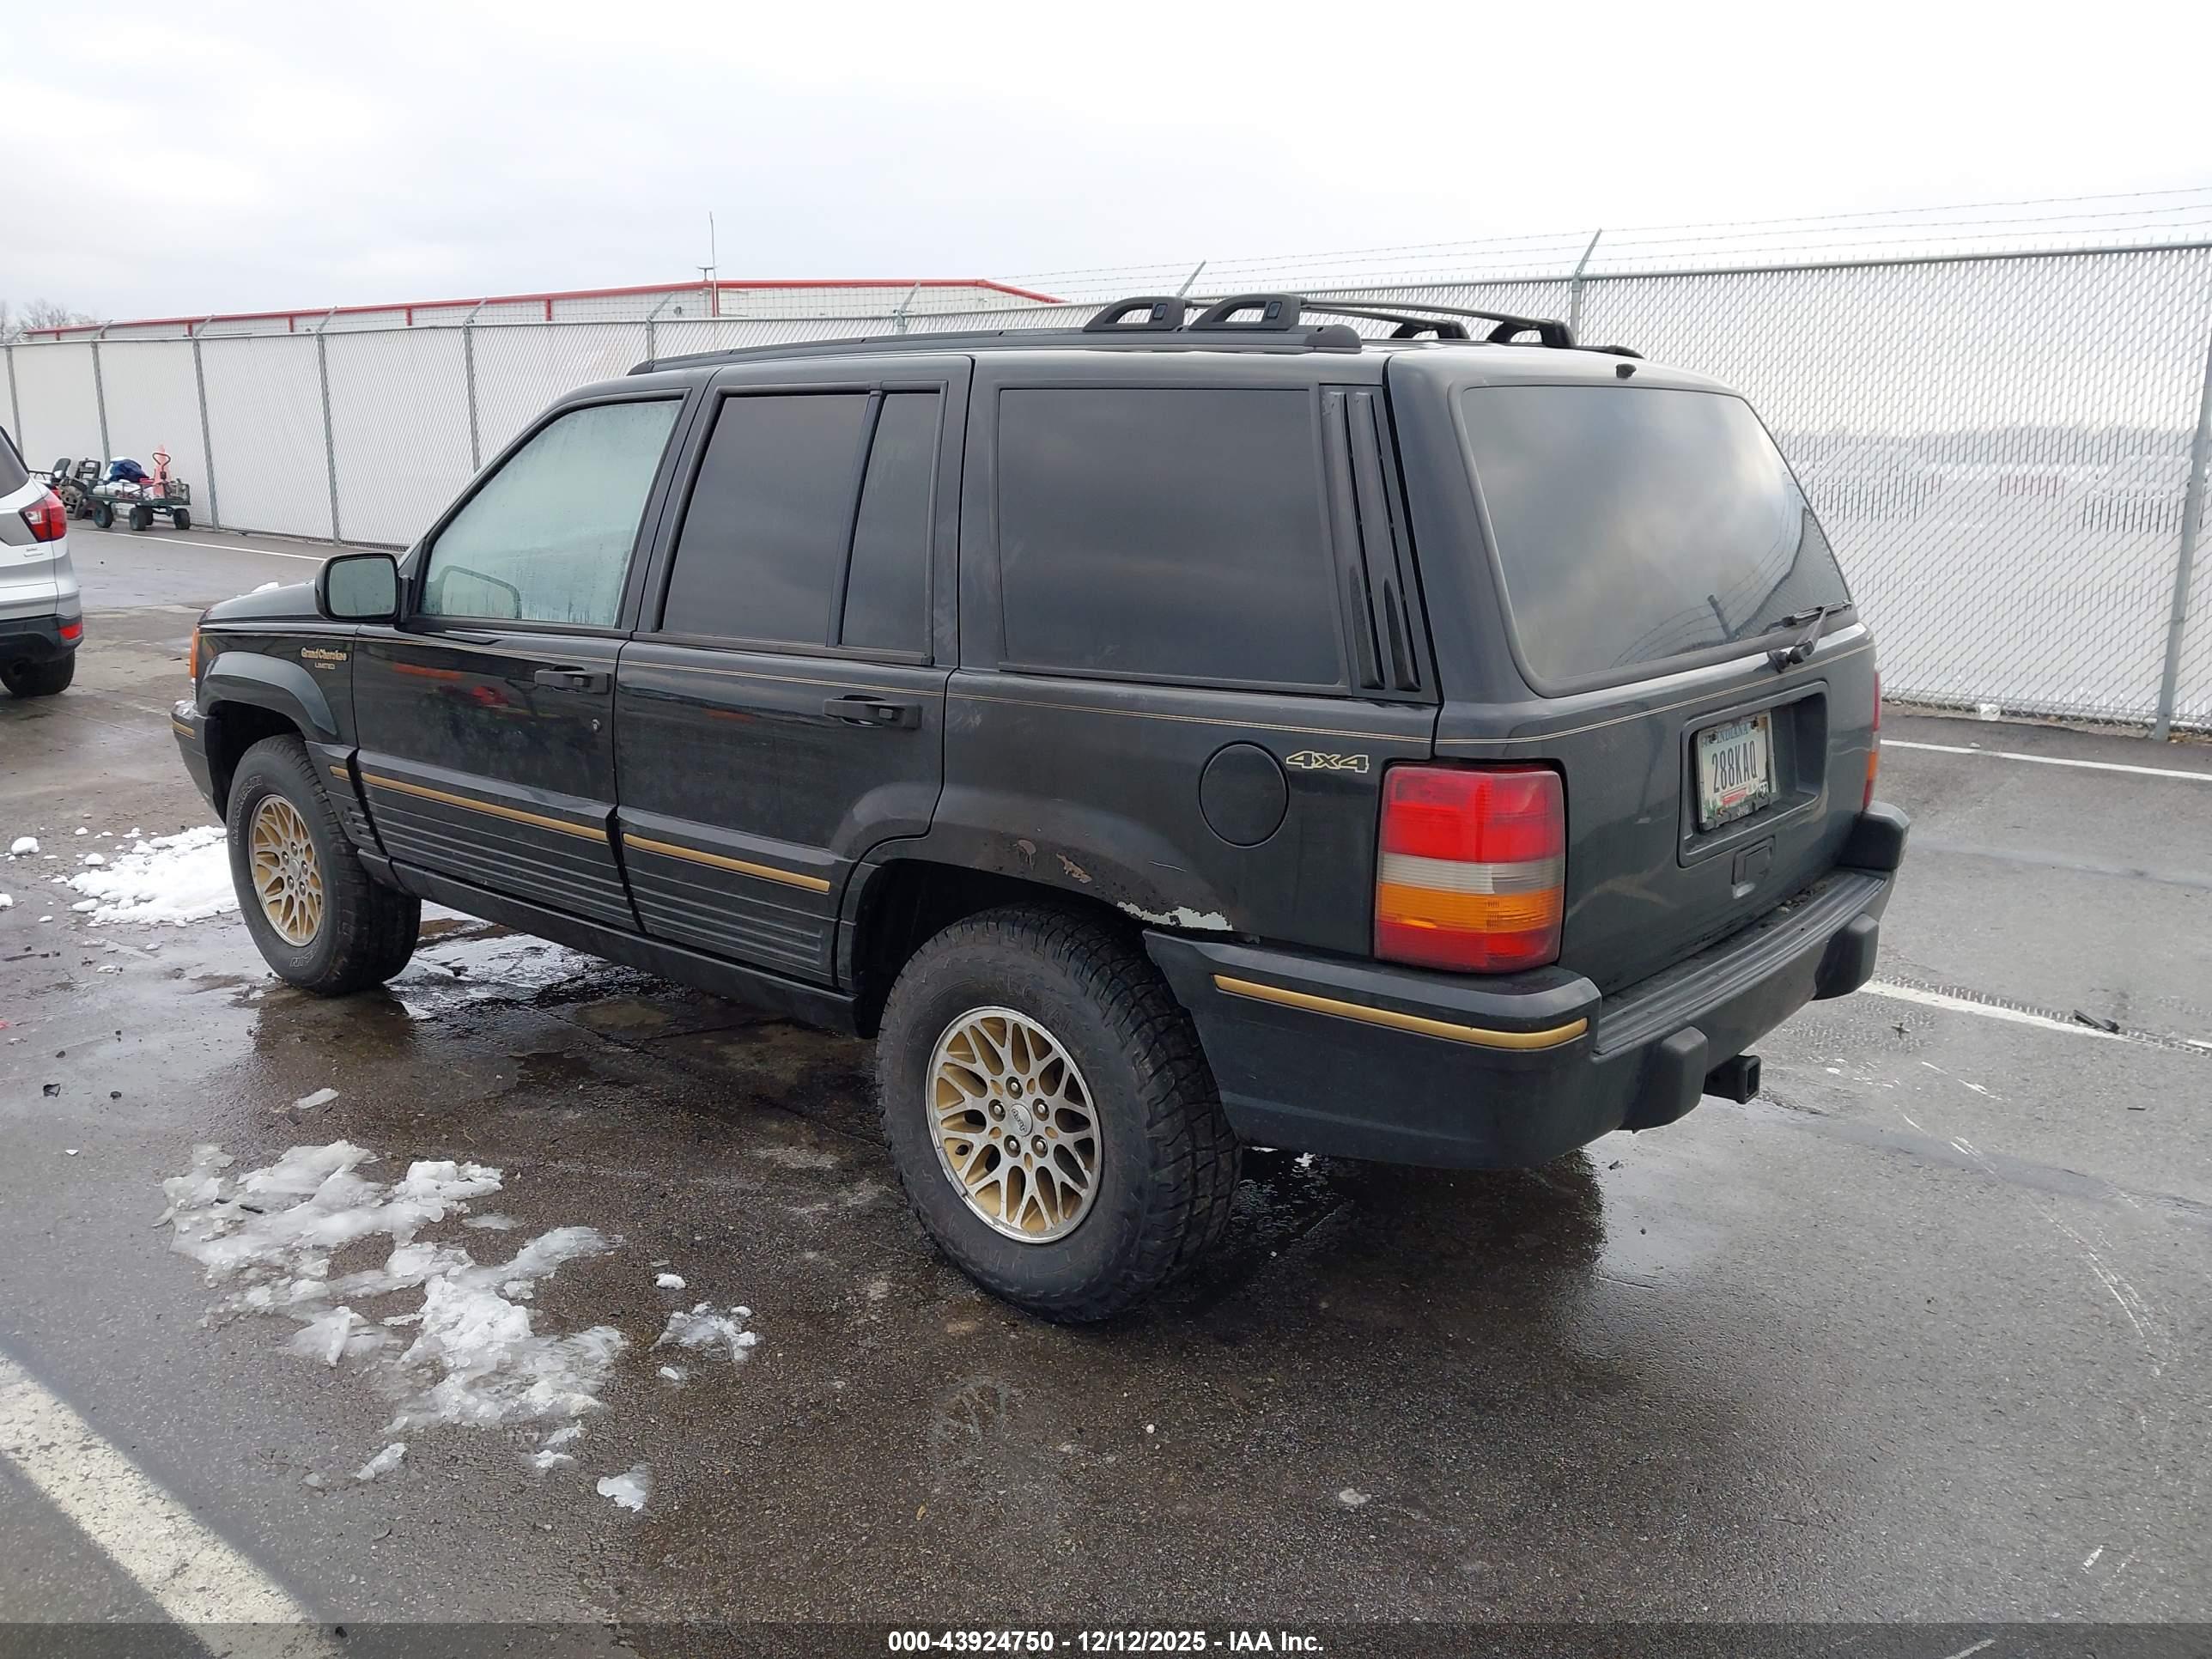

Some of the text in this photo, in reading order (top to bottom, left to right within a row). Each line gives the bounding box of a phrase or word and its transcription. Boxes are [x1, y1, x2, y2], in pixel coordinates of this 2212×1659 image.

[301, 647, 347, 661] Grand Cherokee
[1717, 723, 1748, 744] INDIANA
[1711, 740, 1759, 793] 288KAQ
